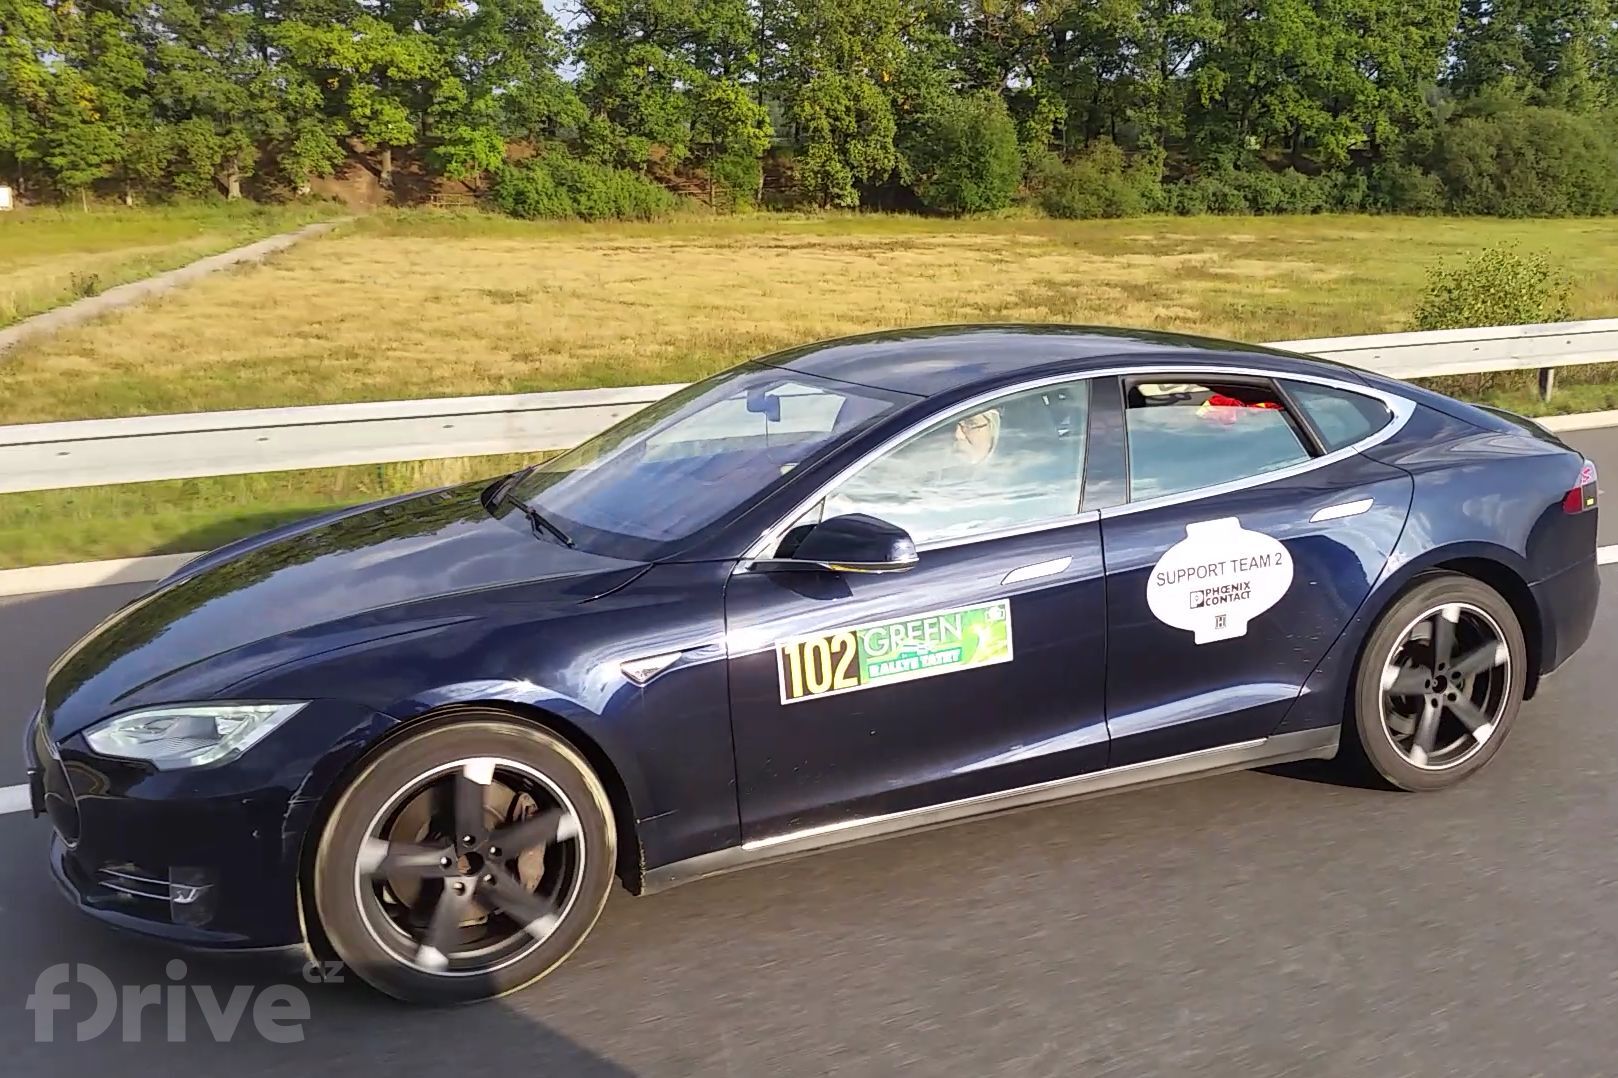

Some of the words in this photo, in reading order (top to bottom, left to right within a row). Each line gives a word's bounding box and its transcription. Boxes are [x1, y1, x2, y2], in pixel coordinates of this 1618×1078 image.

[1156, 562, 1226, 586] SUPPORT
[1230, 554, 1271, 573] TEAM
[1275, 552, 1283, 566] 2
[1205, 590, 1251, 607] CONTACT
[863, 615, 962, 656] GREEN
[785, 631, 858, 698] 102
